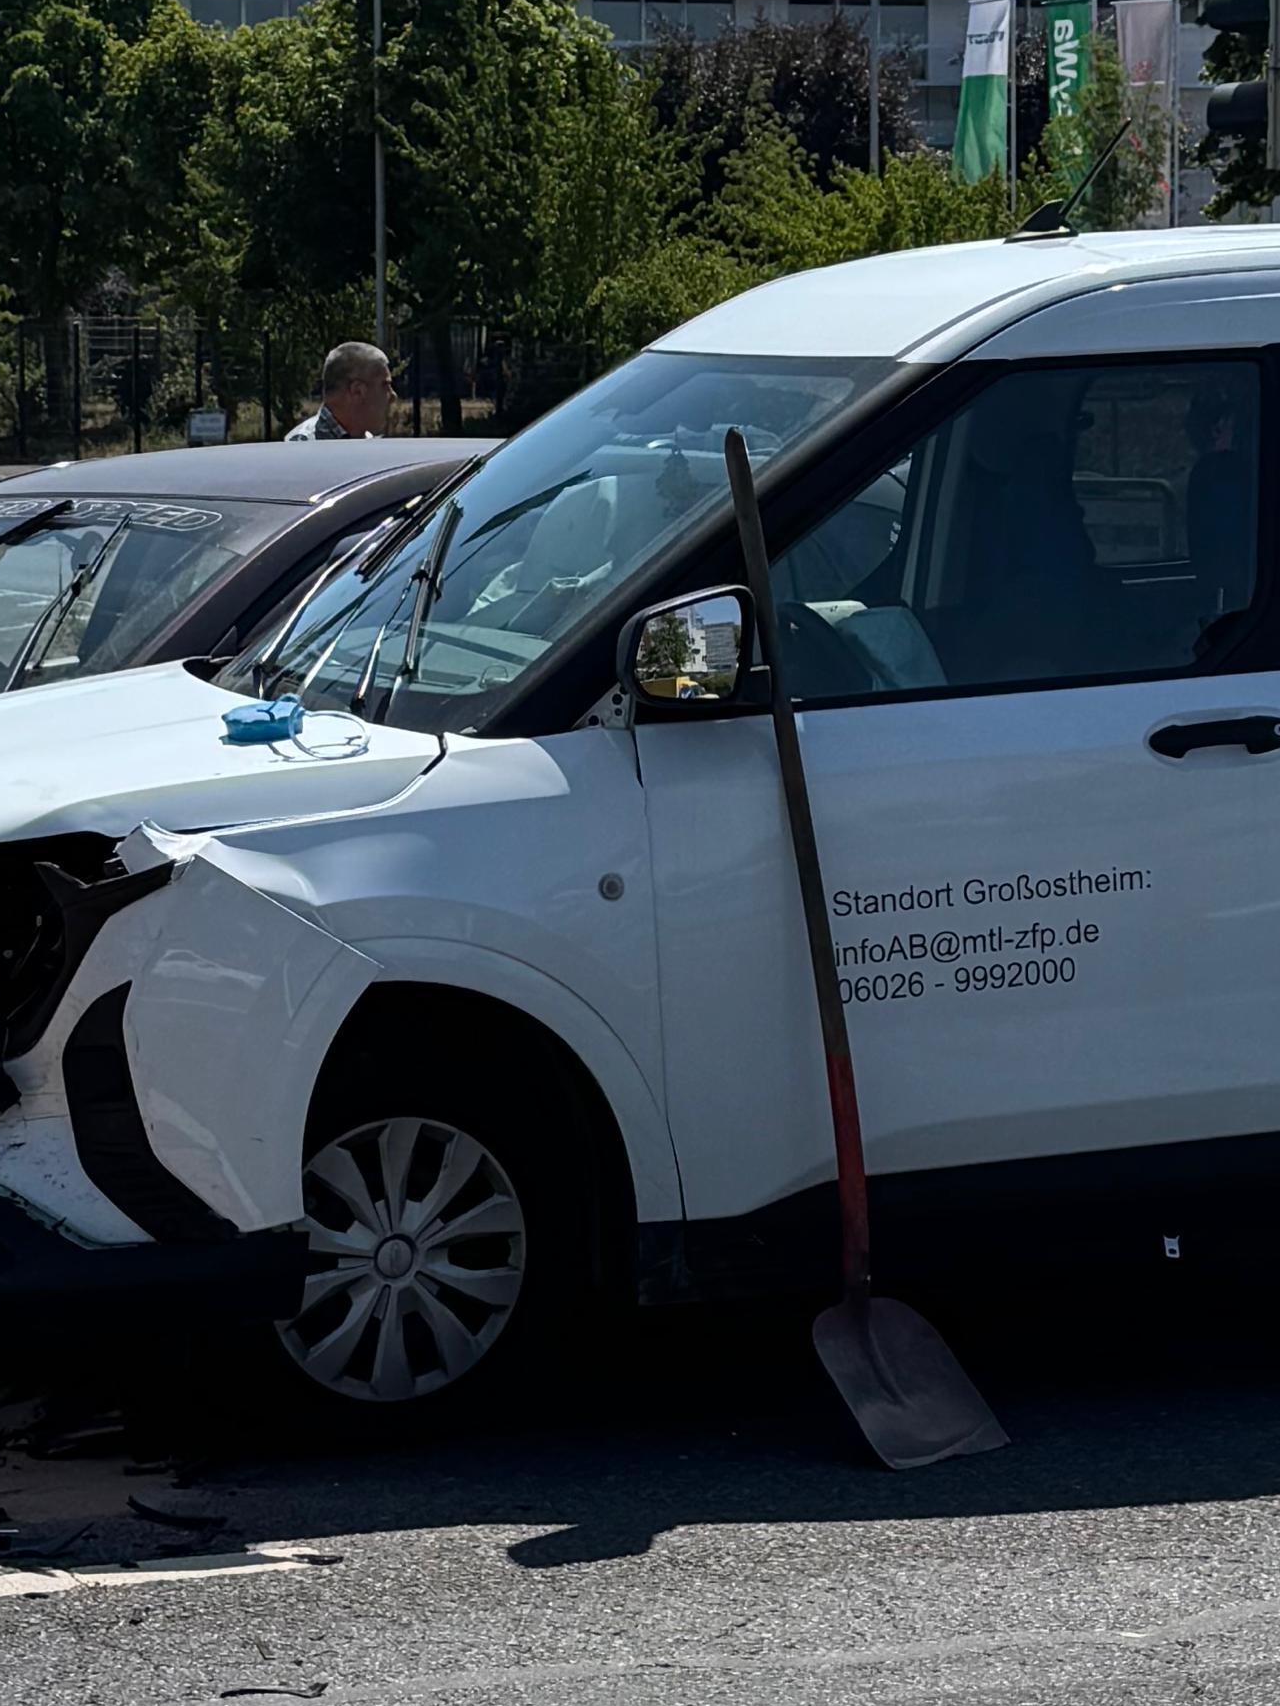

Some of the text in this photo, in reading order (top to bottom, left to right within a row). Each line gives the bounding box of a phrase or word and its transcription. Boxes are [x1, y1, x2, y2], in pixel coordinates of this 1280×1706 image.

[832, 866, 1152, 917] Standort Großostheim:
[835, 919, 1100, 967] infoAB@mtl-zfp.de
[839, 971, 925, 1004] 06026
[953, 957, 1076, 994] 9992000
